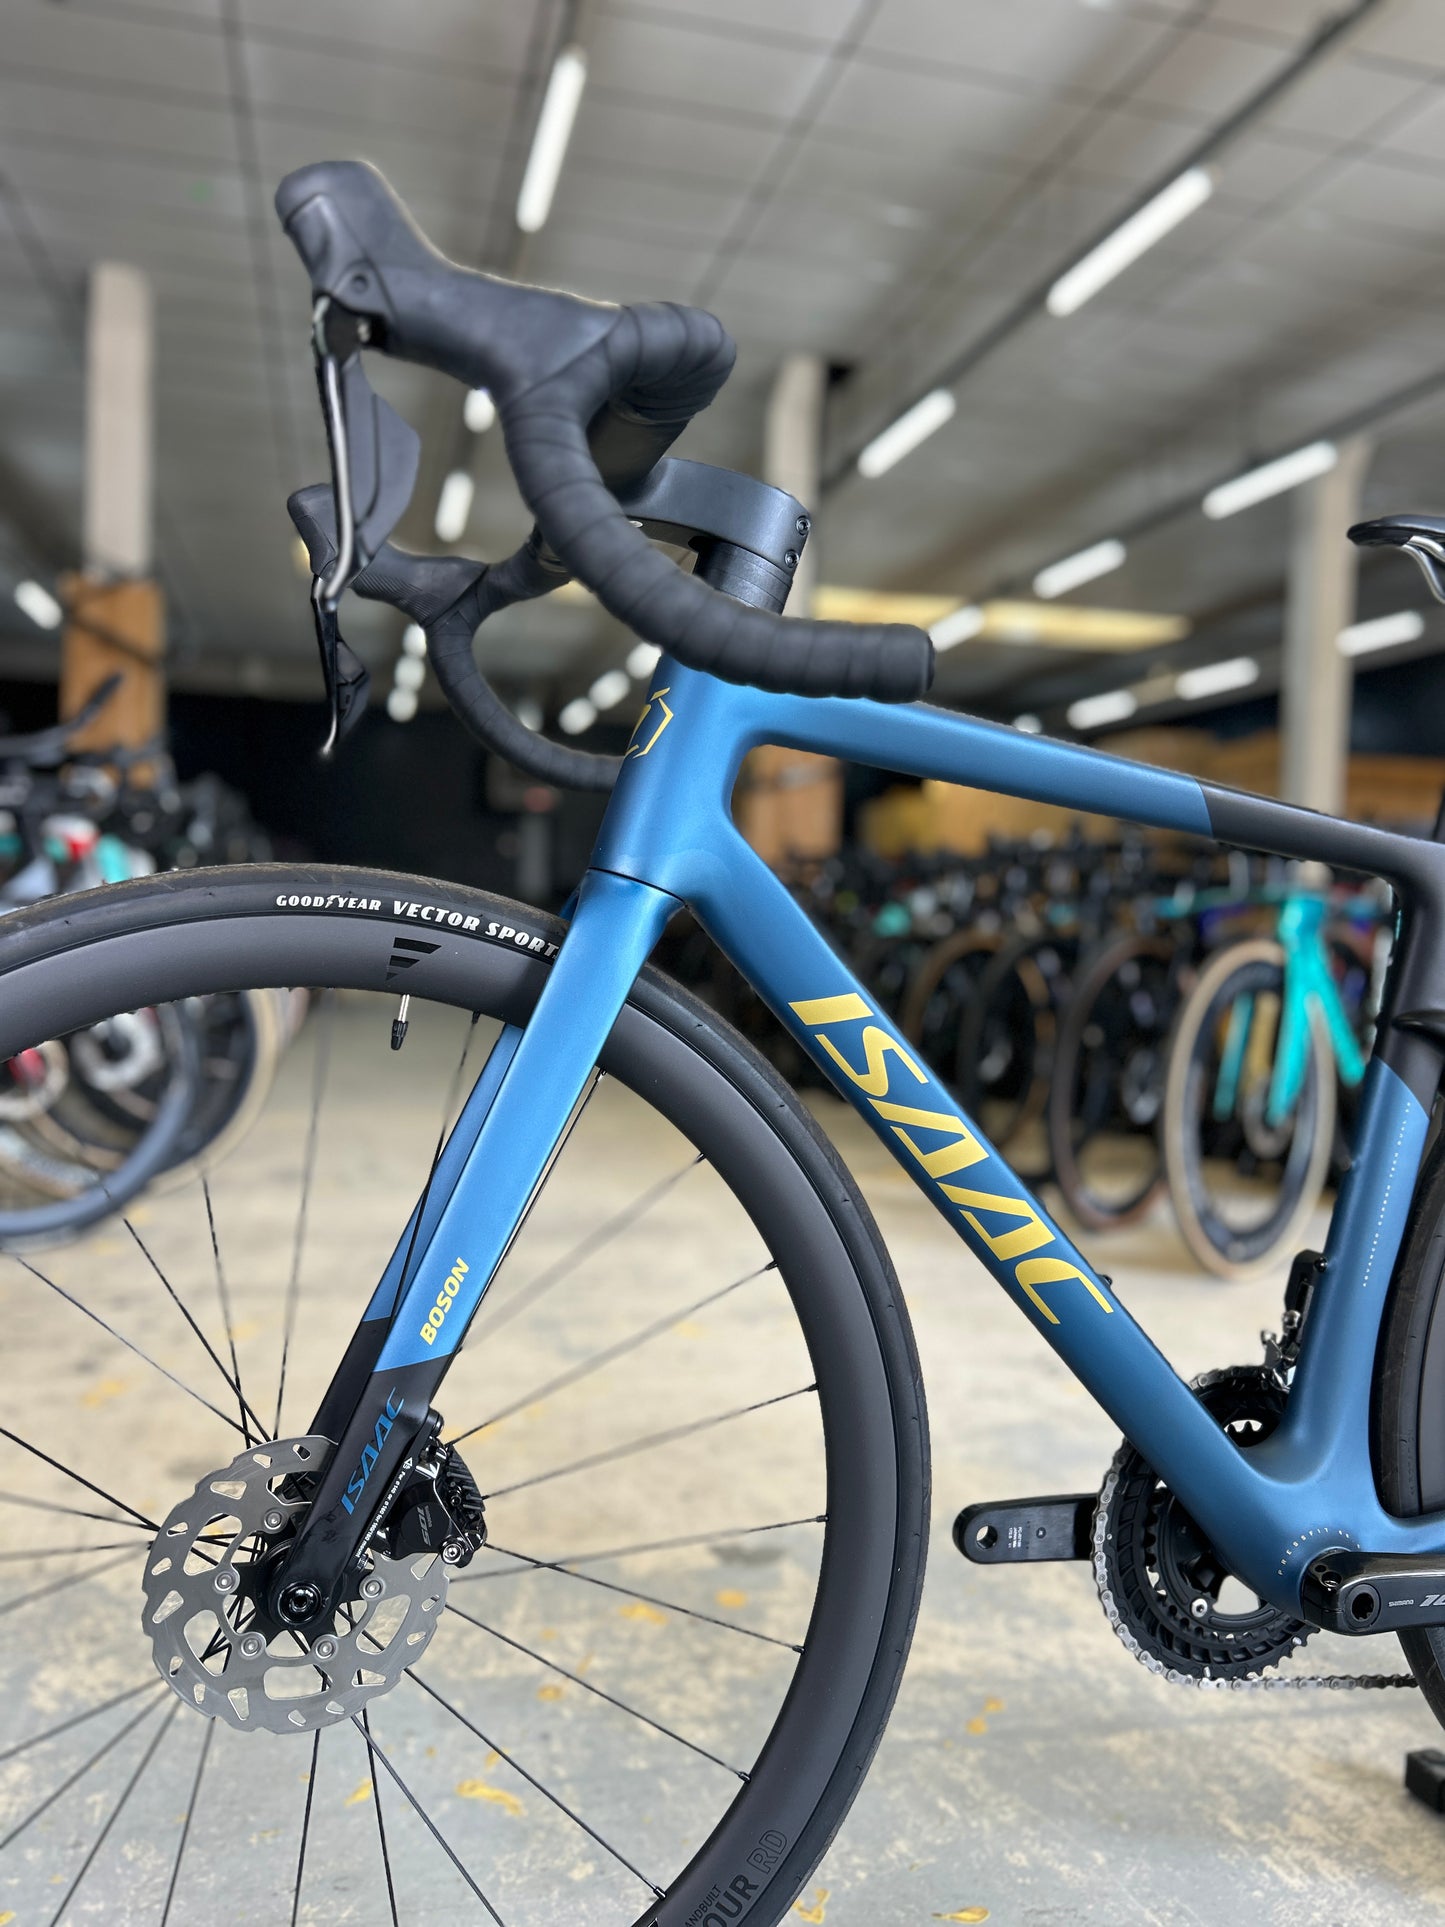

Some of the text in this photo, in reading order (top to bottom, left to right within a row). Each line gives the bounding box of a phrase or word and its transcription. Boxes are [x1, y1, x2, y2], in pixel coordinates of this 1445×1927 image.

[276, 894, 560, 956] GOODYEAR VECTOR SPORT
[788, 992, 1114, 1325] ISAAC
[420, 1257, 470, 1346] BOSON
[342, 1386, 404, 1515] ISAAC
